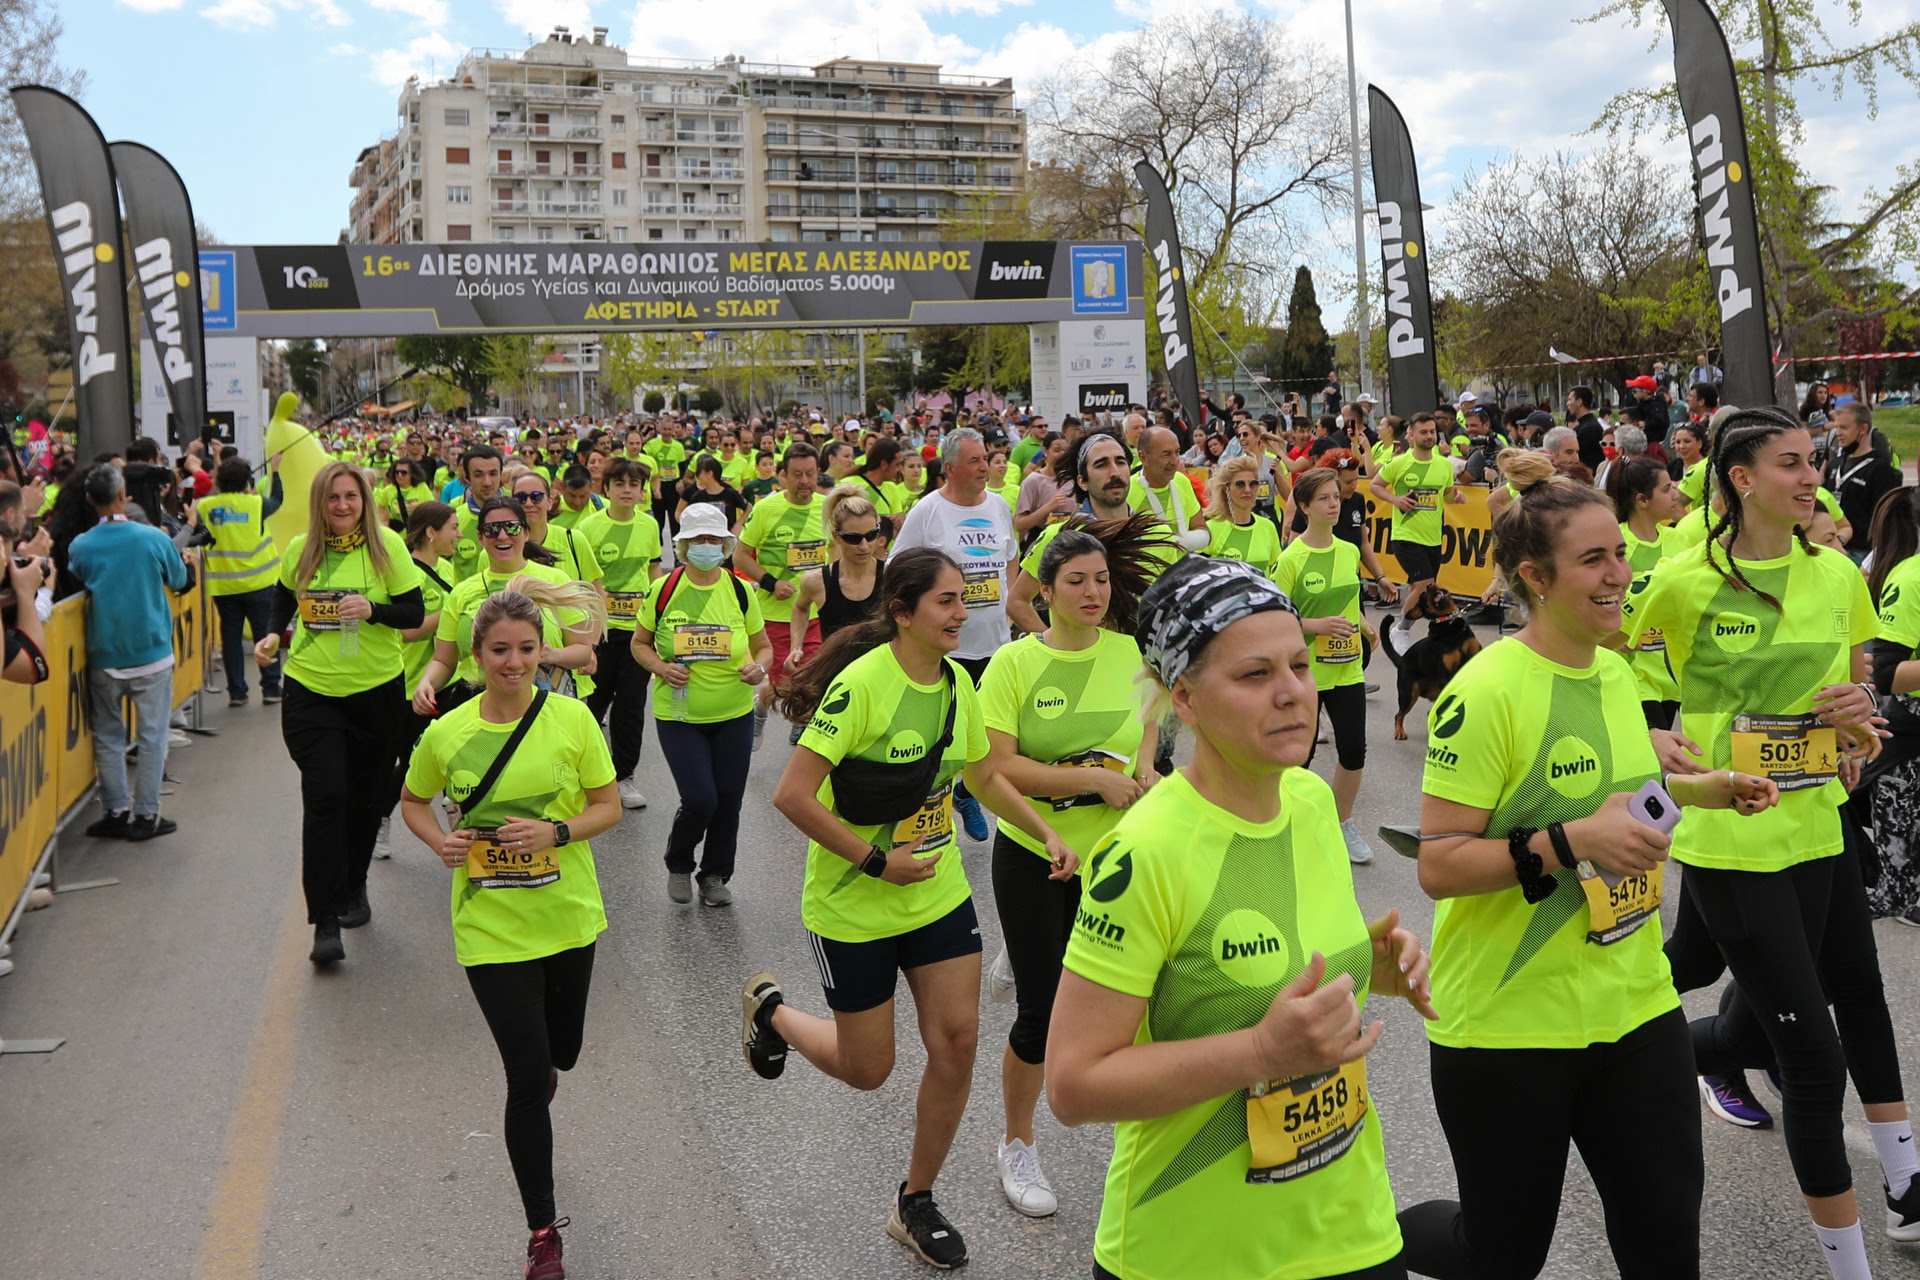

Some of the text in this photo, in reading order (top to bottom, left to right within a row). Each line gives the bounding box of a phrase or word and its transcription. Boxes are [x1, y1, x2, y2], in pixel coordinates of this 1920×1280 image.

[418, 253, 538, 275] ΔΙΕΘΝΗΣ
[547, 252, 719, 274] ΜΑΡΑΘΩΝΙΟΣ
[729, 252, 808, 272] ΜΕΓΑΣ
[815, 250, 971, 271] ΑΛΕΞΑΝΔΡΟΣ
[990, 259, 1043, 281] bwin
[455, 274, 895, 299] Δρόμος Υγείας και Δυναμικού Βαδίσματος 5.000μ
[584, 300, 698, 320] ΑΦΕΤΗΡΙΑ
[716, 299, 781, 318] START
[1084, 389, 1127, 408] bwin
[796, 551, 818, 559] 5172
[1305, 577, 1325, 587] bwin
[610, 600, 634, 609] 5194
[1715, 621, 1756, 637] bwin
[688, 636, 718, 646] 8145
[1328, 638, 1353, 650] 5035
[1037, 696, 1064, 708] bwin
[890, 744, 923, 758] bwin
[1760, 740, 1810, 762] 5037
[1551, 755, 1596, 779] bwin
[916, 807, 944, 829] 5199
[1610, 874, 1648, 908] 5478
[1222, 933, 1280, 961] bwin
[1283, 1077, 1348, 1133] 5458
[1292, 1111, 1346, 1144] LEKKA SOFIA
